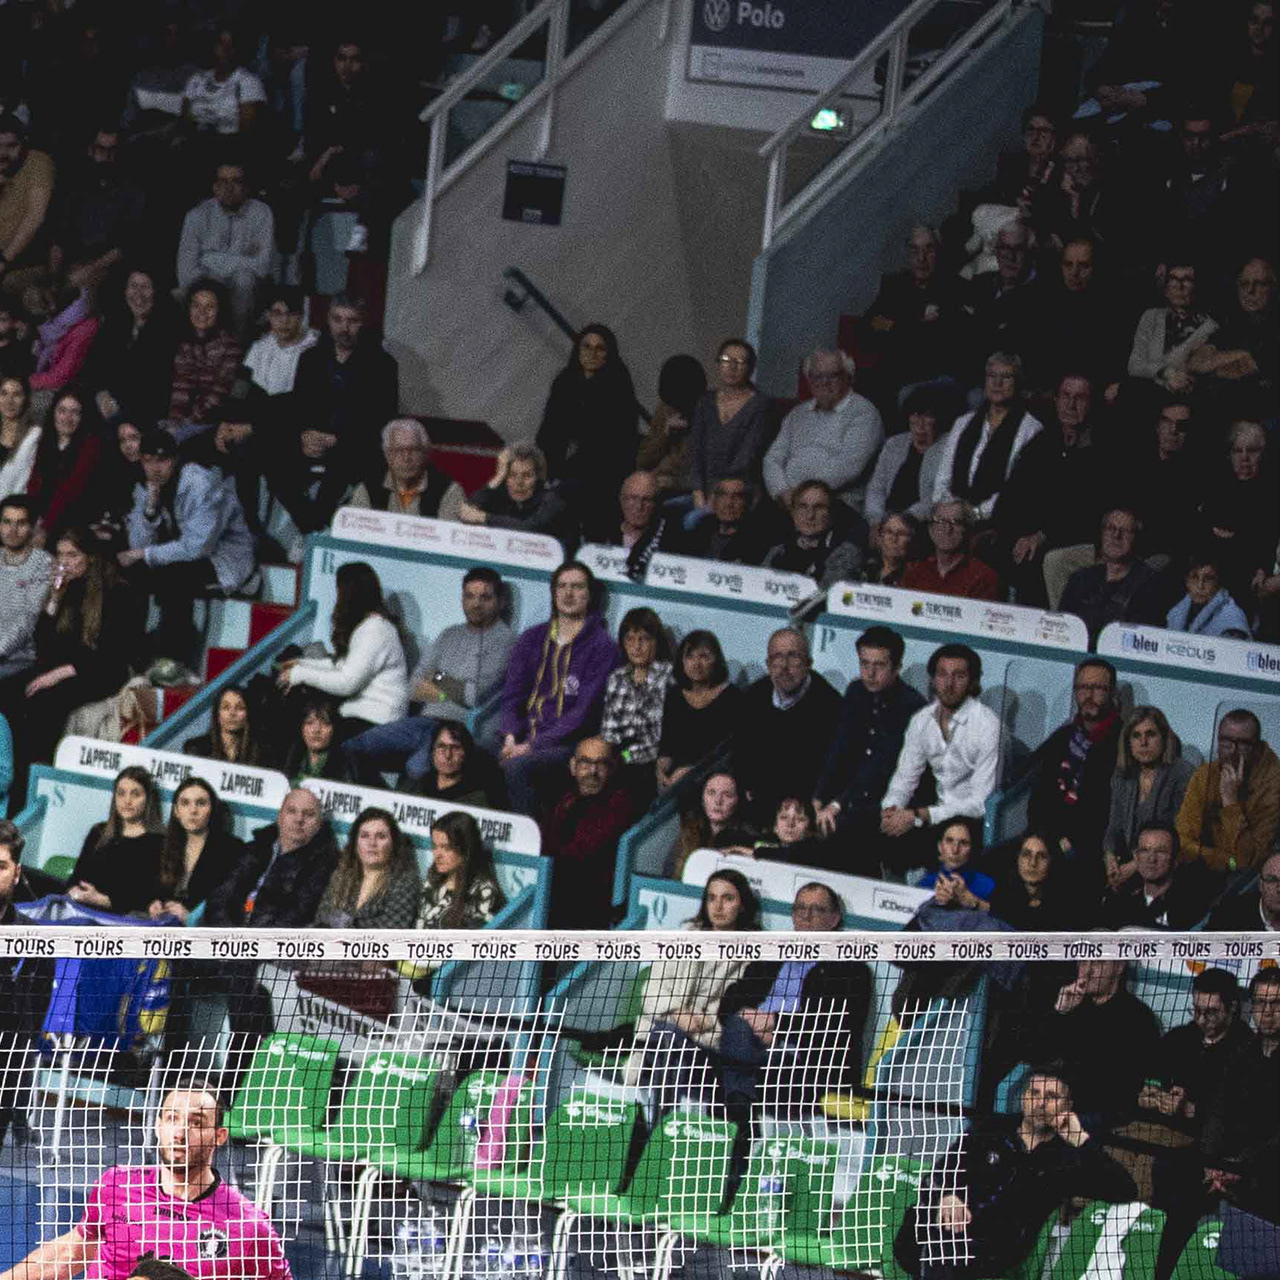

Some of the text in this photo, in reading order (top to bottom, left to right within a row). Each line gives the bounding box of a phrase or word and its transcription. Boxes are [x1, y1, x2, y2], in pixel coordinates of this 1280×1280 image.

[736, 2, 786, 29] Polo
[4, 938, 55, 955] TOURS
[74, 939, 124, 956] TOURS
[142, 940, 192, 957] TOURS
[210, 940, 259, 957] TOURS
[275, 941, 325, 958] TOURS
[341, 942, 389, 959] TOURS
[406, 943, 454, 959] TOURS
[471, 943, 517, 959] TOURS
[533, 943, 580, 959] TOURS
[595, 943, 641, 959] TOURS
[656, 943, 702, 960] TOURS
[717, 943, 761, 960] TOURS
[777, 943, 820, 960] TOURS
[836, 943, 879, 959] TOURS
[893, 943, 936, 959] TOURS
[950, 943, 993, 959] TOURS
[1006, 943, 1049, 959] TOURS
[1061, 942, 1103, 959] TOURS
[1170, 942, 1211, 959] TOURS
[1224, 942, 1264, 959] TOURS
